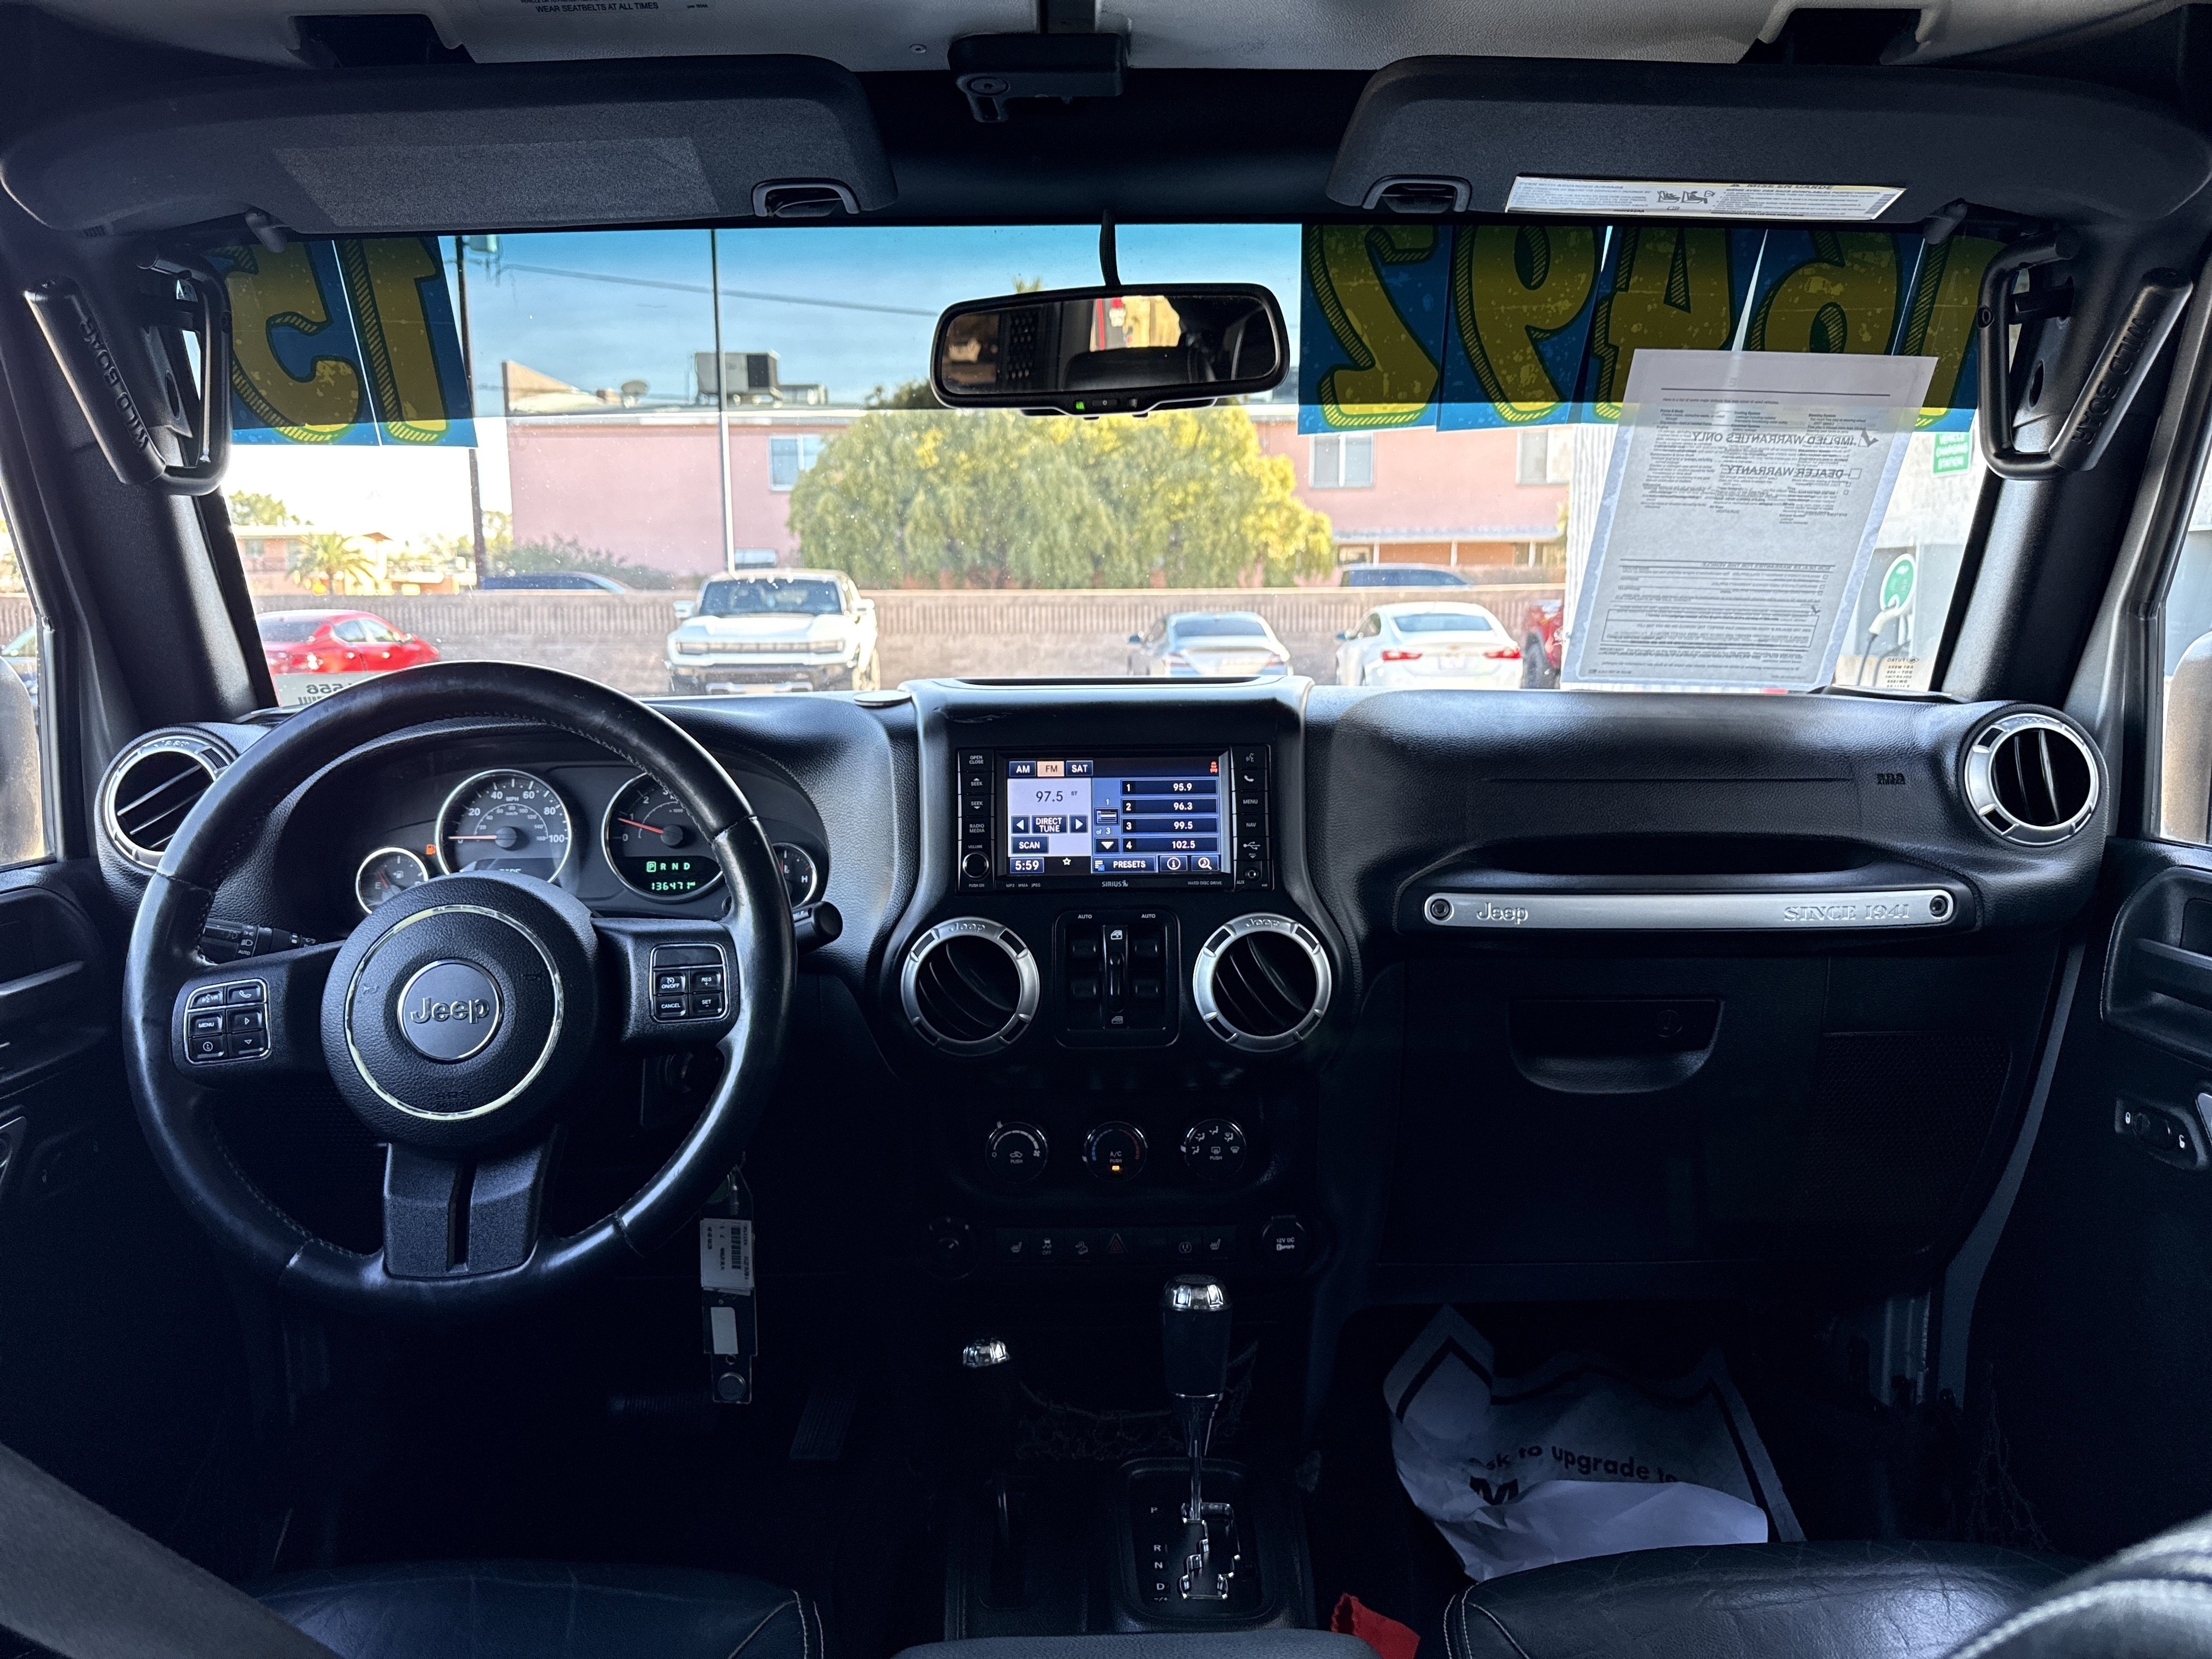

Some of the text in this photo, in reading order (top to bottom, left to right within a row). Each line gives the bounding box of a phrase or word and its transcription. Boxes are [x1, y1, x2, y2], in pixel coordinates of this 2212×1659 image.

[535, 5, 560, 14] WEAR
[562, 3, 606, 12] SEATBELTS
[1071, 764, 1088, 773] SAT
[1126, 783, 1192, 792] 1 95.9
[490, 791, 503, 799] 40
[523, 791, 535, 799] 60
[1036, 791, 1063, 802] 97.5
[544, 806, 556, 815] 80
[1126, 802, 1193, 811] 2 96.3
[468, 808, 481, 816] 20
[1126, 821, 1193, 830] 3 99.5
[549, 834, 565, 843] 100
[622, 833, 629, 842] 0
[1126, 840, 1195, 849] 4 102.5
[683, 862, 690, 870] D
[1015, 860, 1039, 871] 5:59
[1113, 860, 1146, 868] PRESETS
[651, 882, 690, 890] 136471
[1476, 902, 1528, 925] Jeep
[1783, 904, 1910, 922] SINCE 1941
[949, 922, 985, 933] Jeep
[1245, 918, 1280, 929] Jeep
[410, 997, 490, 1024] Jeep
[1518, 1445, 1543, 1458] to
[1551, 1446, 1650, 1480] upgrade
